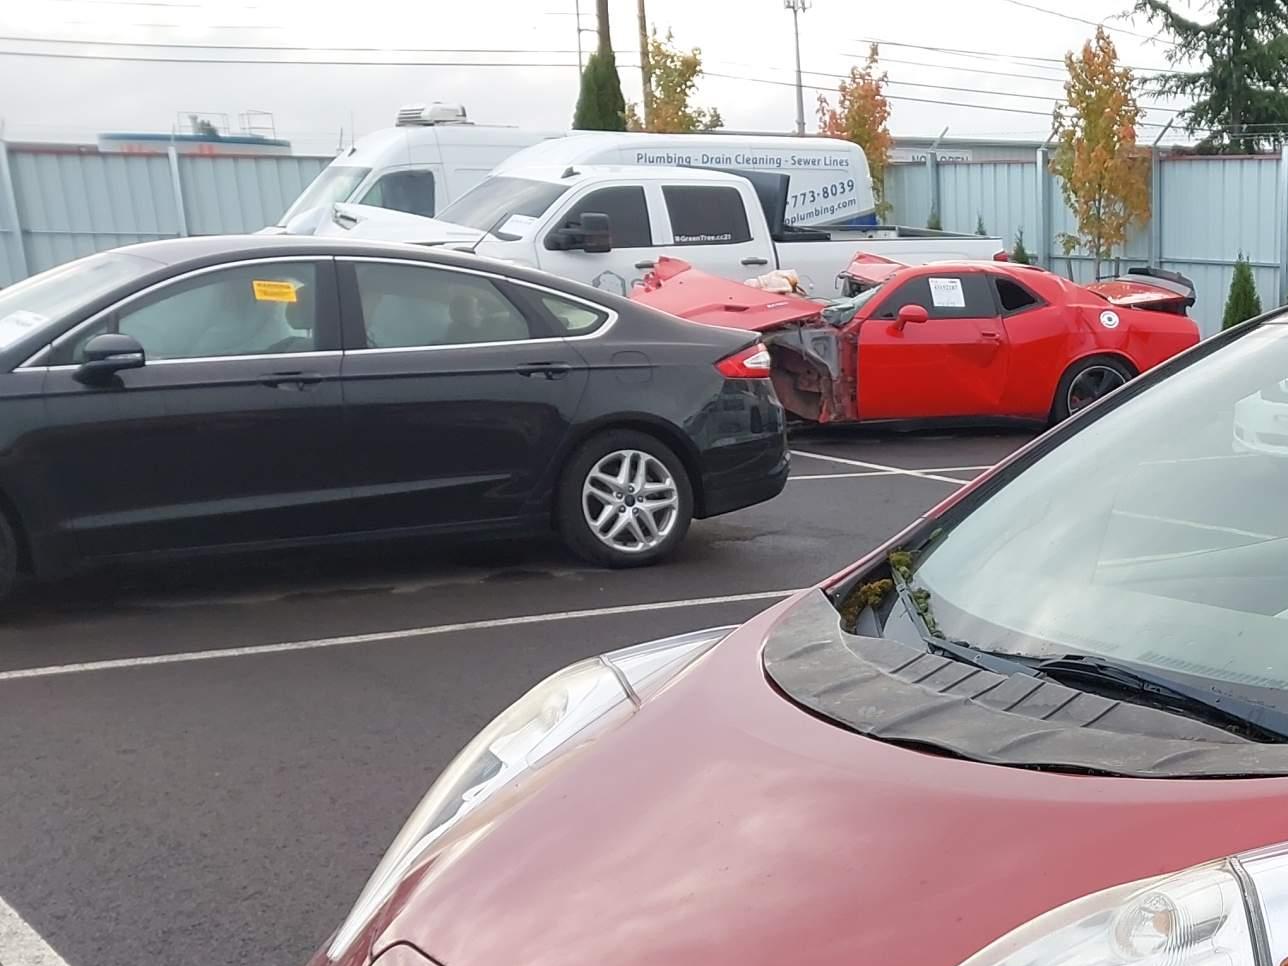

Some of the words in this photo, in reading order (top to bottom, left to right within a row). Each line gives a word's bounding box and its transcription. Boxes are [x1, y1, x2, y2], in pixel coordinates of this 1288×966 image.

[636, 153, 691, 165] Plumbing
[701, 153, 732, 165] Drain
[735, 154, 782, 168] Cleaning
[791, 155, 822, 166] Sewer
[823, 155, 849, 167] Lines
